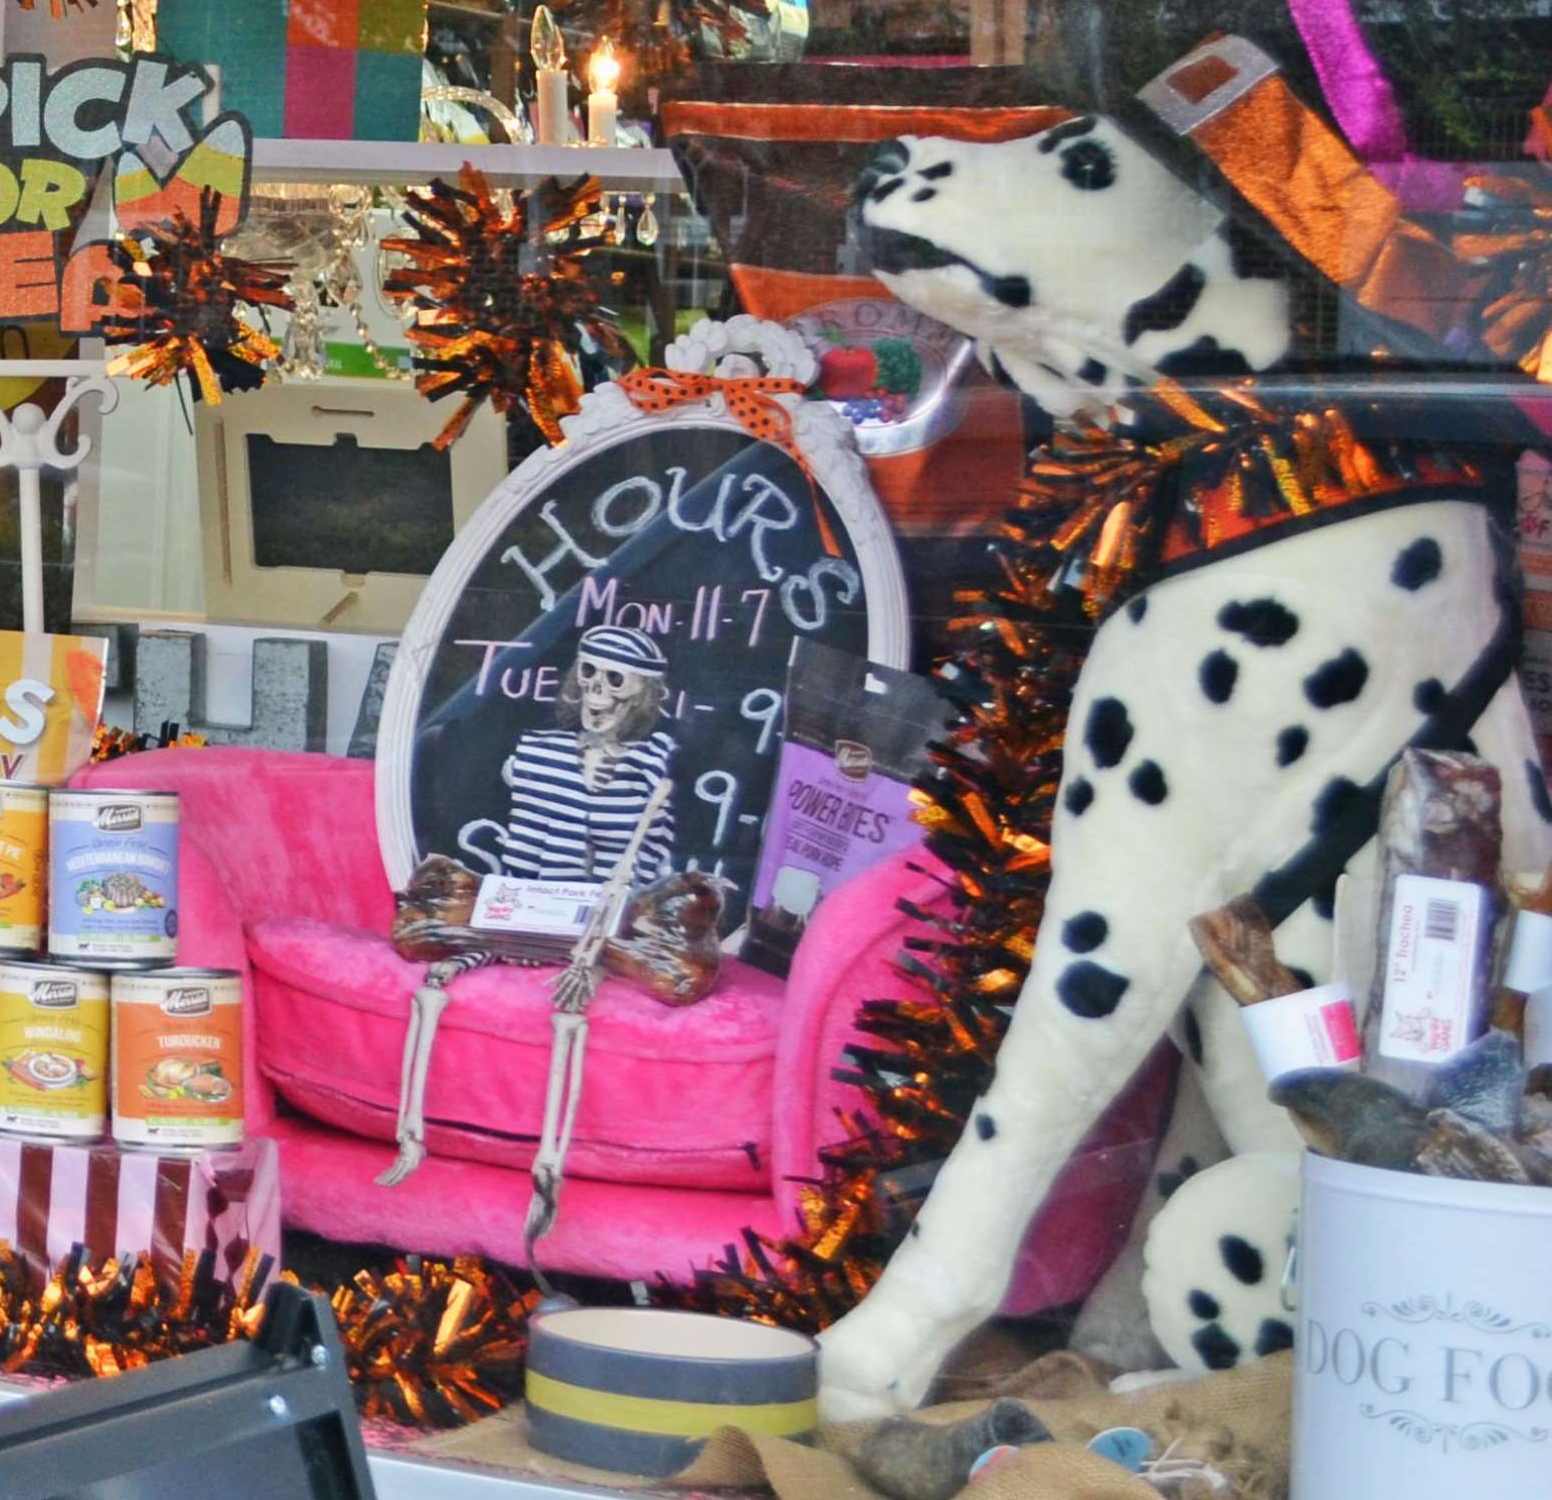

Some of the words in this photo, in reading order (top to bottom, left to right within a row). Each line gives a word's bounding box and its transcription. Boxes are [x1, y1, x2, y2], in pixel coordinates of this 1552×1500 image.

[501, 467, 860, 632] HOURS
[454, 639, 559, 702] TUE
[789, 779, 843, 828] POWER
[156, 1034, 222, 1050] TURDUCKEN
[1305, 1319, 1412, 1395] DOG
